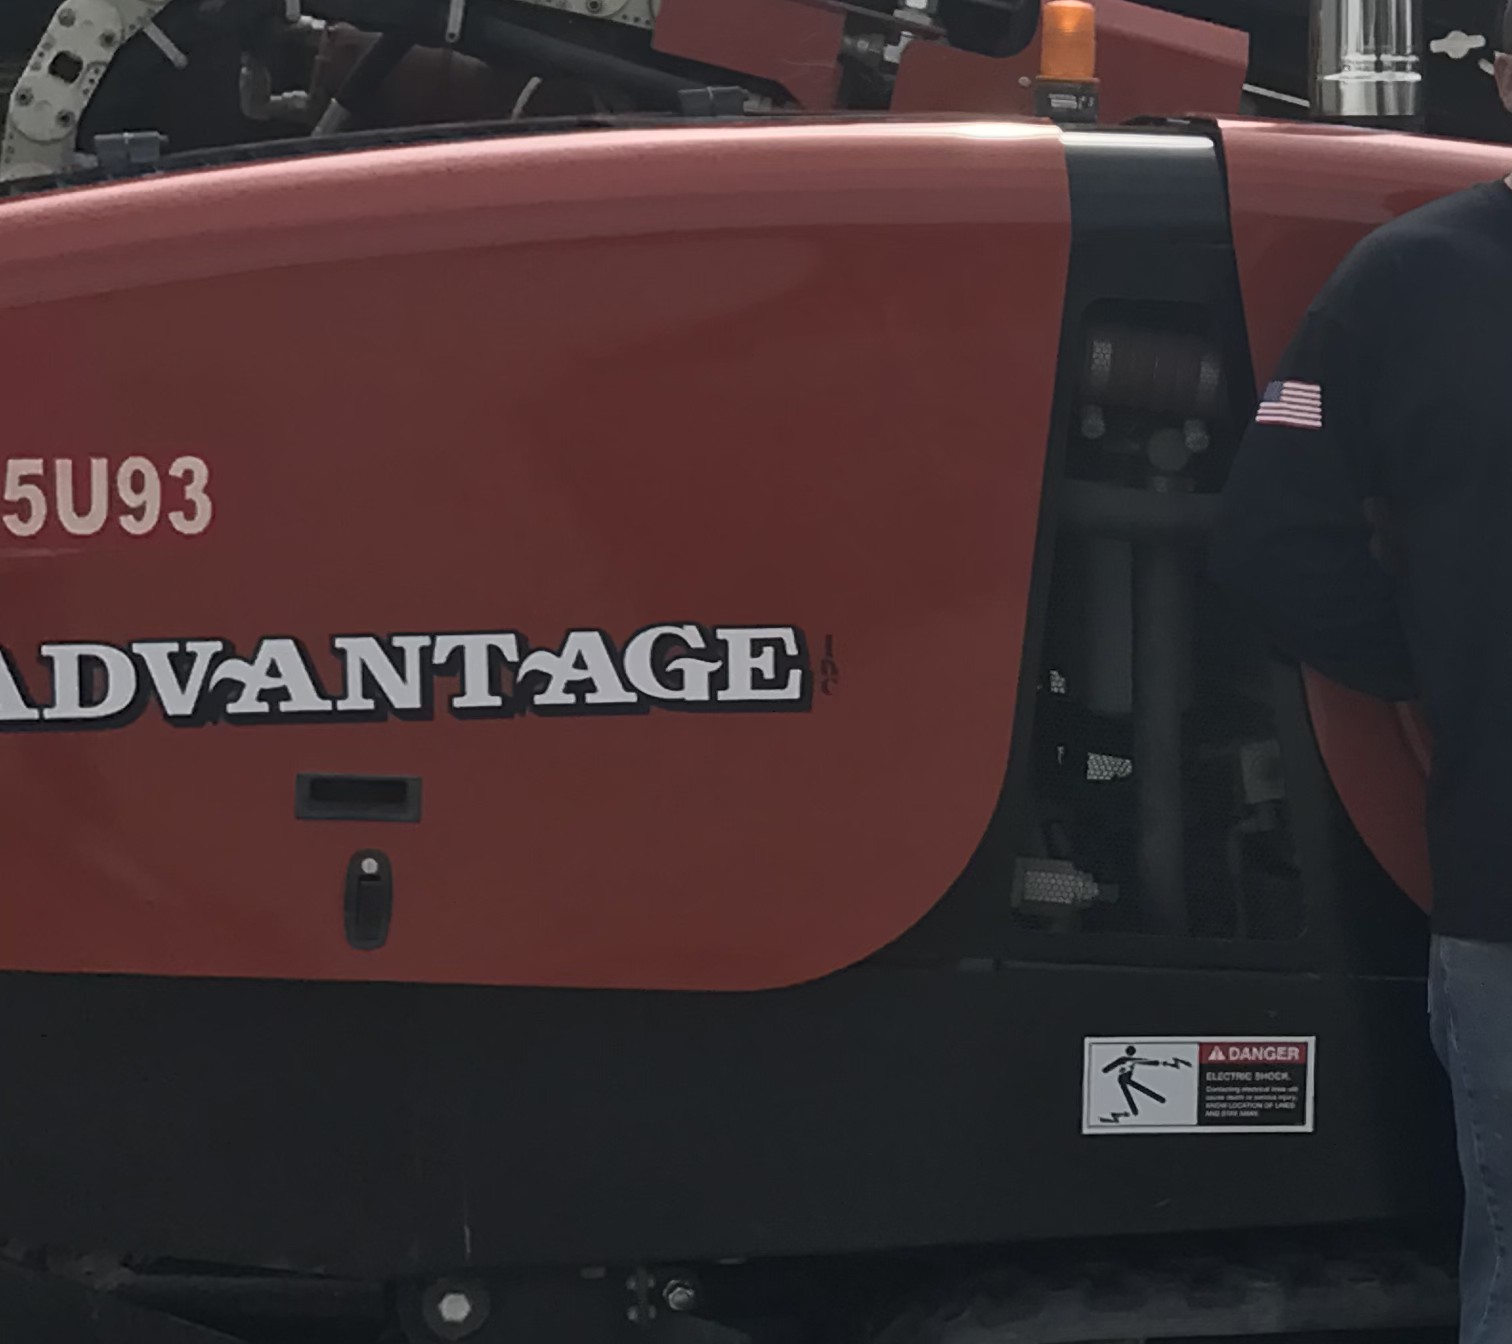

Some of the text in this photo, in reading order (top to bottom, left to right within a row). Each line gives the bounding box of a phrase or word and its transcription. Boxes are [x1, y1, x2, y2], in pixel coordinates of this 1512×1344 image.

[2, 455, 214, 537] 5U93
[1229, 1046, 1300, 1061] DANGER
[1205, 1071, 1253, 1081] ELECTRIC
